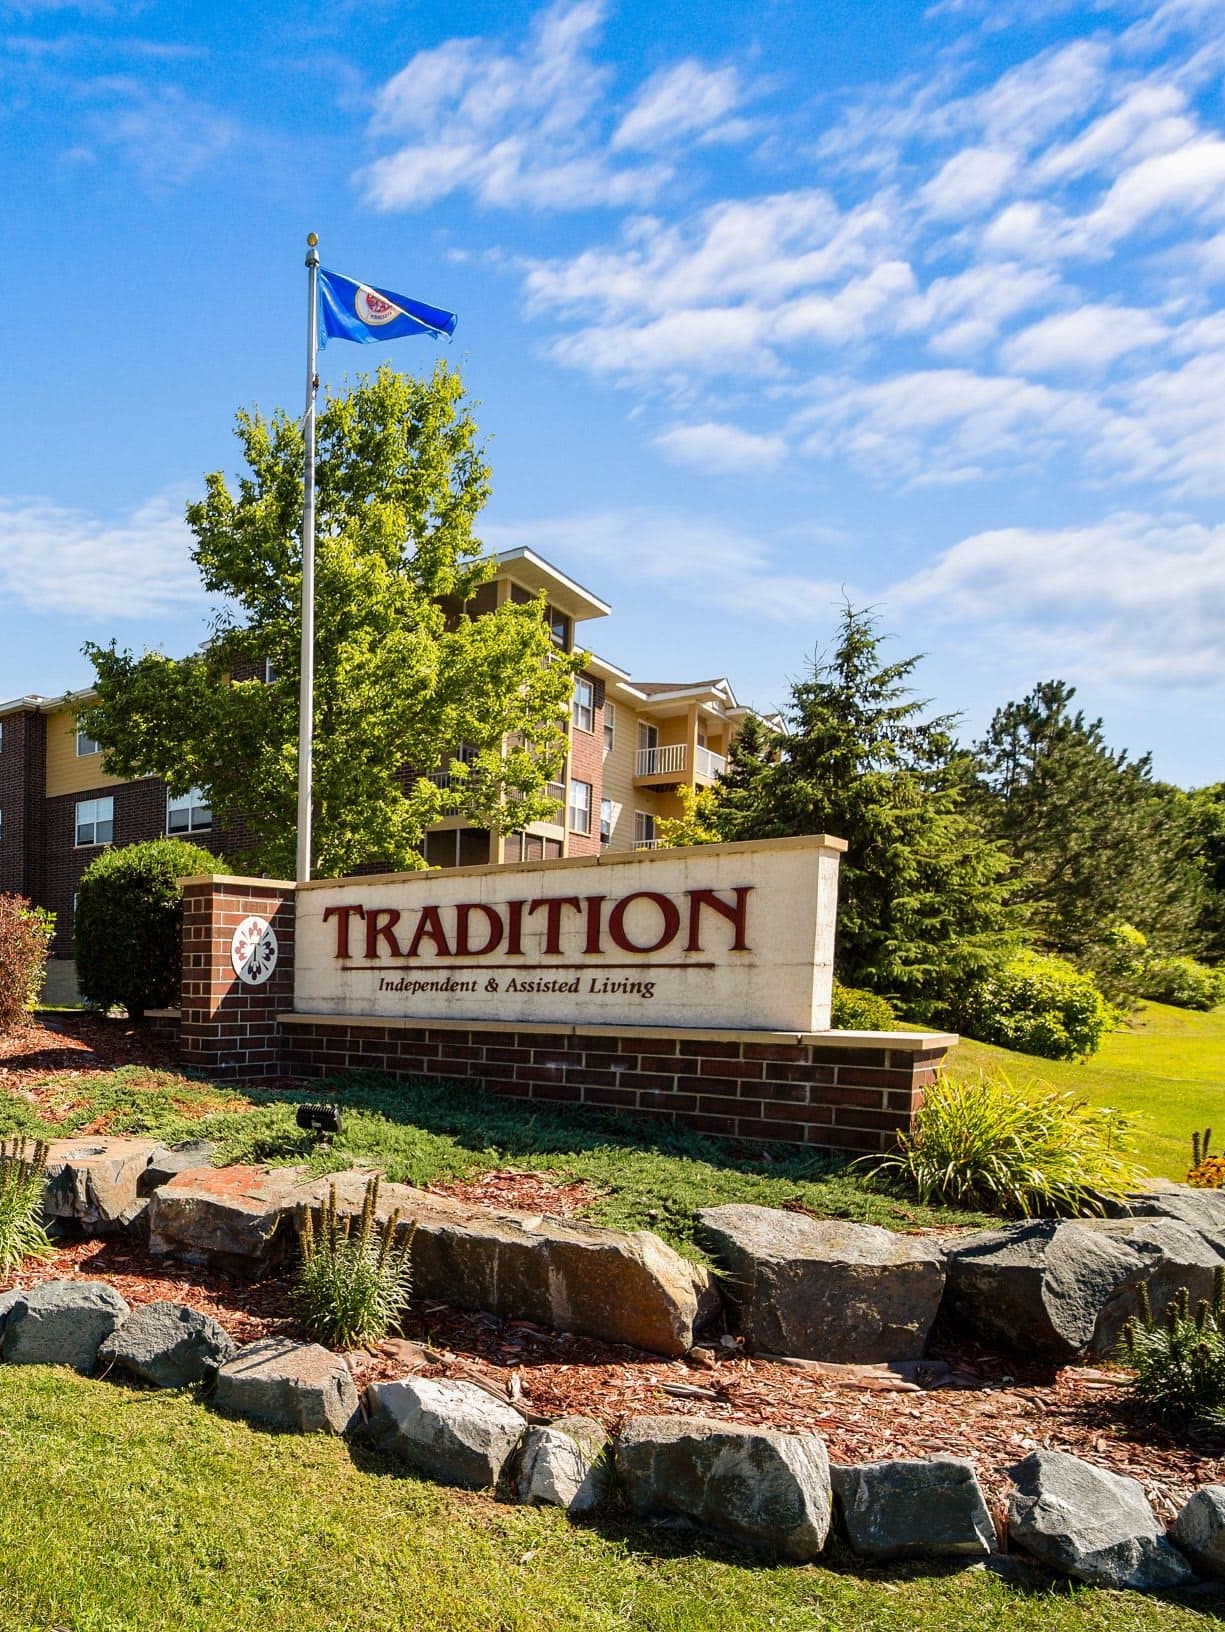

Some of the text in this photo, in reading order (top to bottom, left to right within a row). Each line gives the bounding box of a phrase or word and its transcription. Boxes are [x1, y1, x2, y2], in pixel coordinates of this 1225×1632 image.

[322, 886, 755, 958] TRADITION
[378, 977, 656, 998] Independent & Assisted Living
